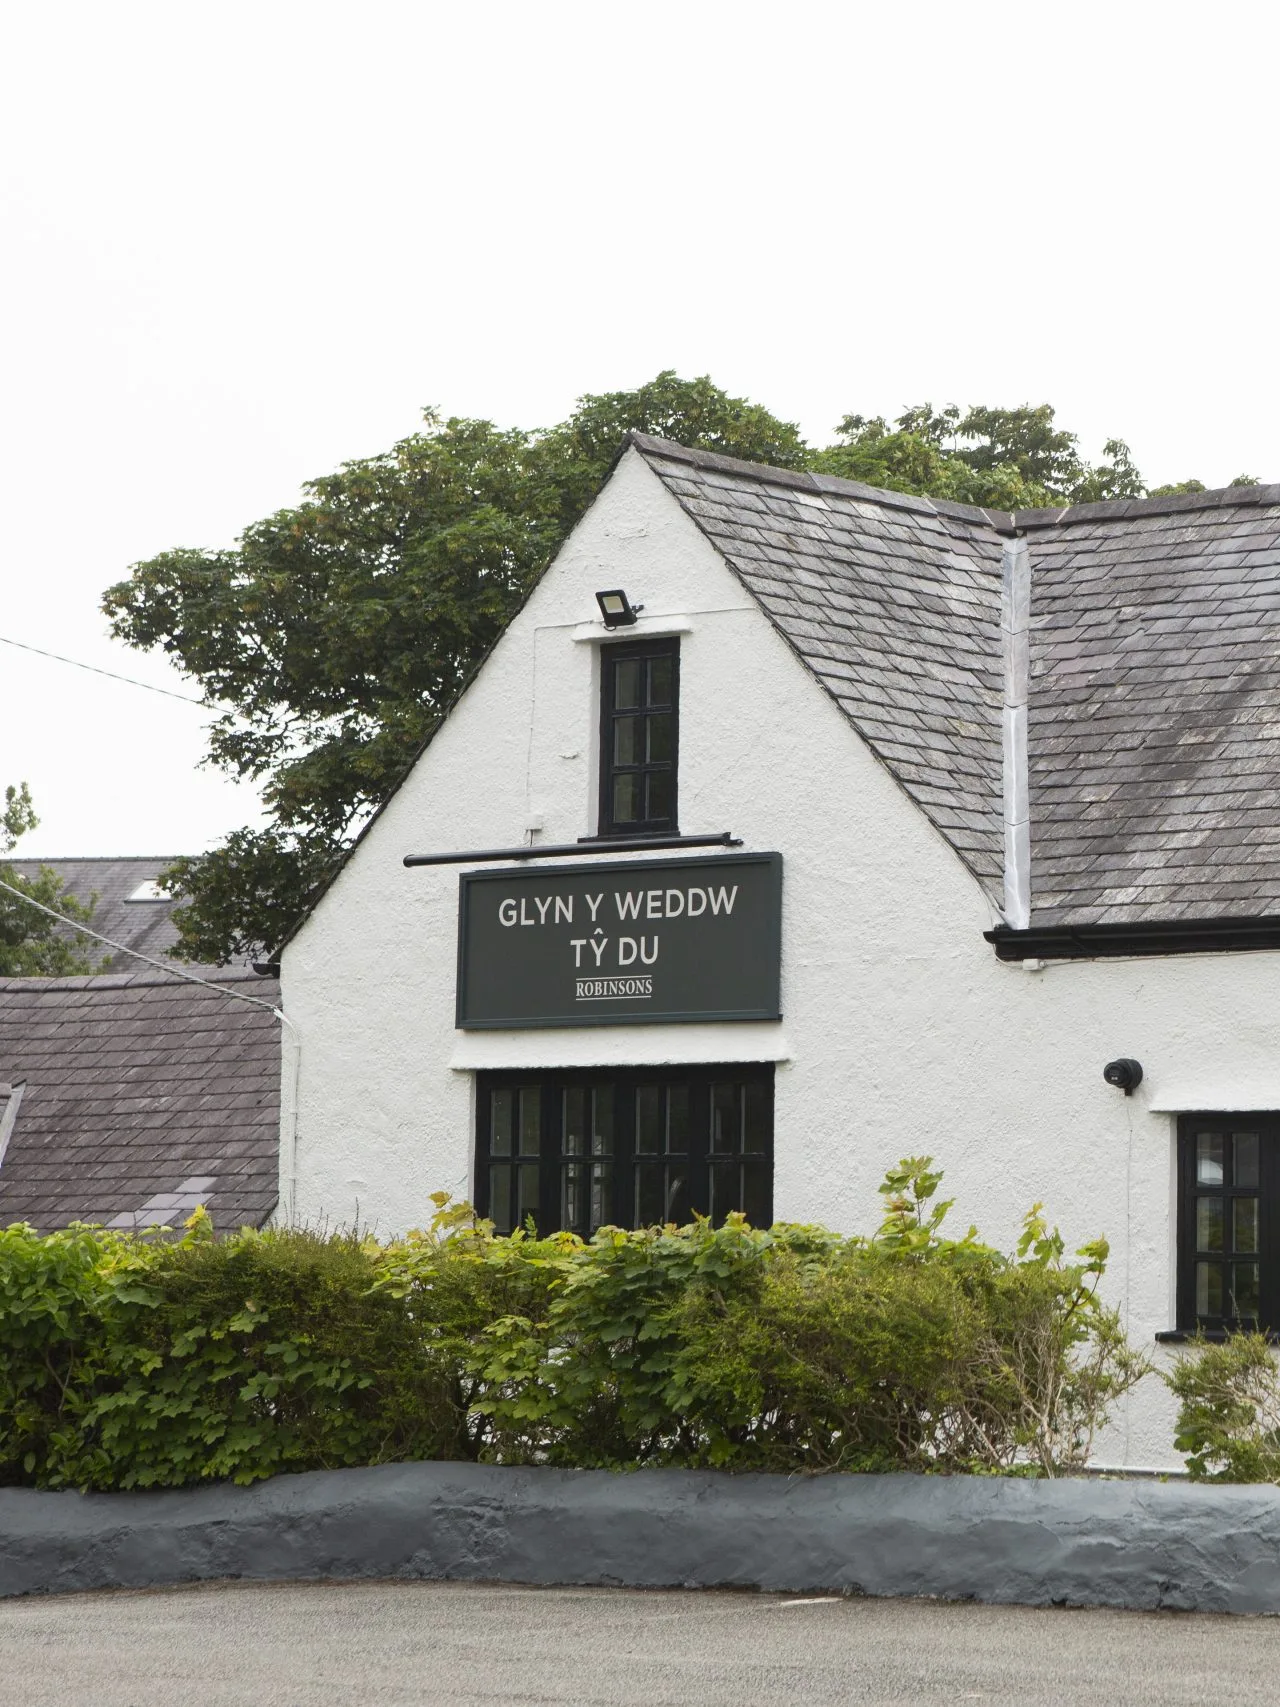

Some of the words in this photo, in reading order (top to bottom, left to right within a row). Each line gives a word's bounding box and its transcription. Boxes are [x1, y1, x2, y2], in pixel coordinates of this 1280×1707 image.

[499, 895, 573, 927] GLYN
[585, 893, 604, 922] Y
[615, 885, 738, 920] WEDDW
[570, 928, 608, 967] TŶ
[619, 936, 659, 966] DU
[576, 979, 652, 997] ROBINSONS
